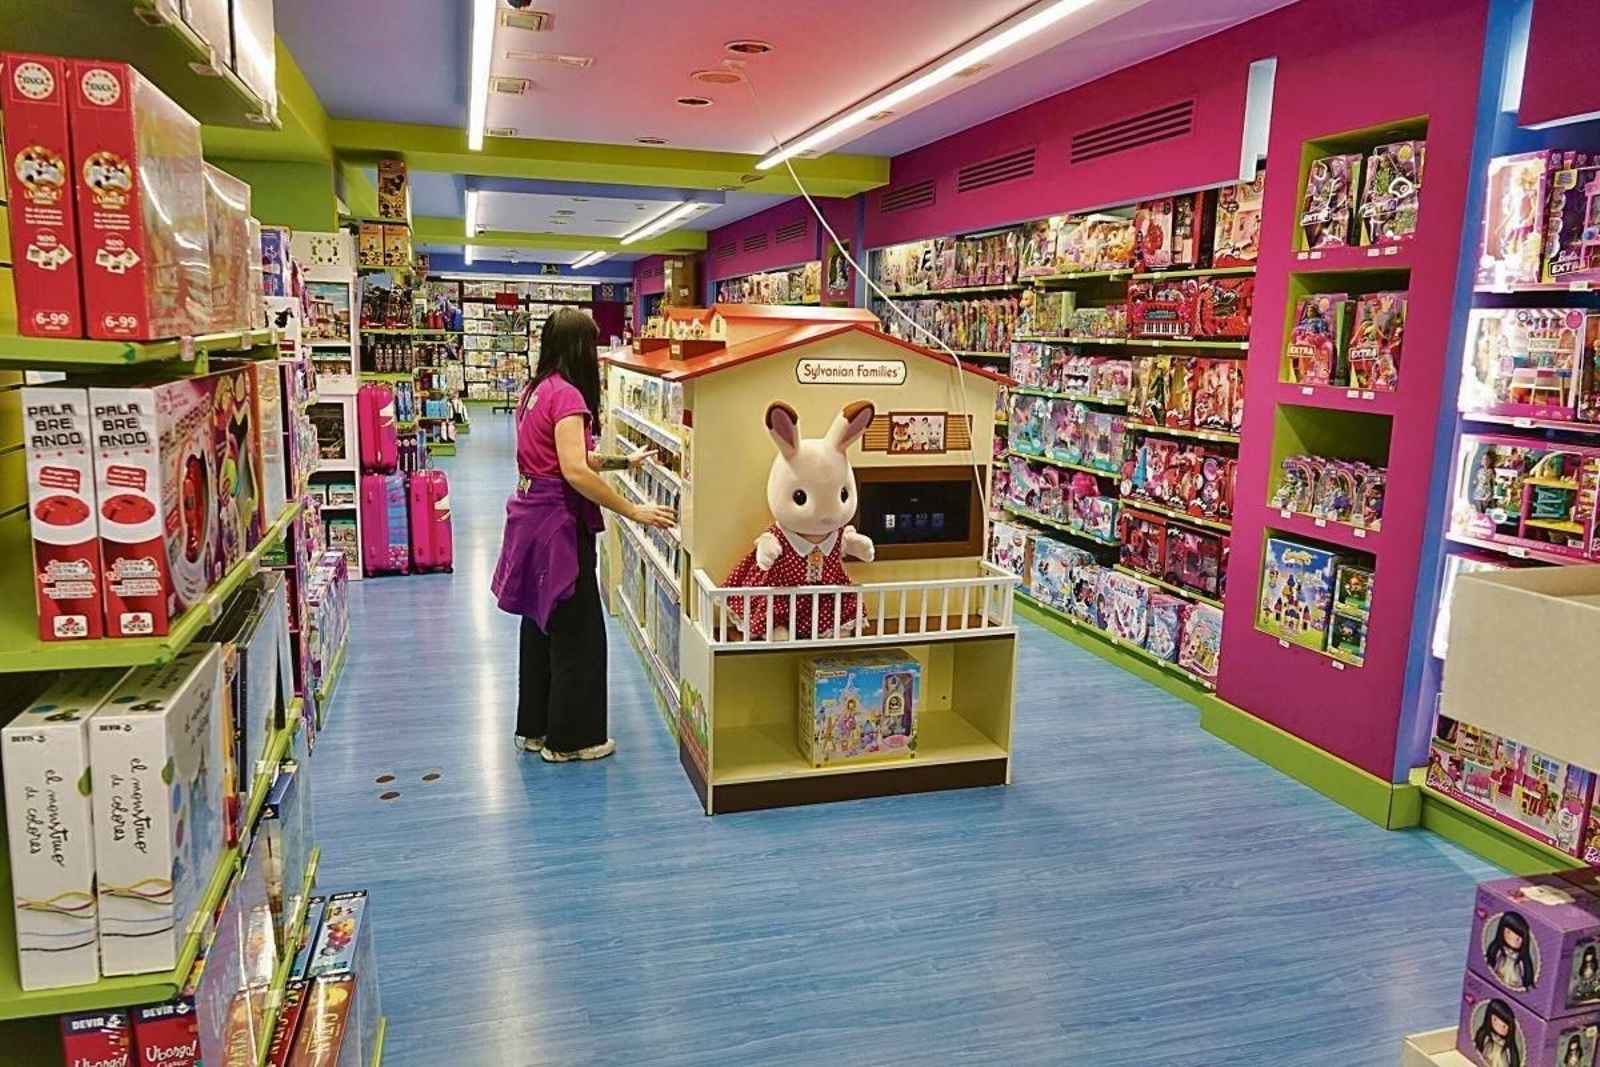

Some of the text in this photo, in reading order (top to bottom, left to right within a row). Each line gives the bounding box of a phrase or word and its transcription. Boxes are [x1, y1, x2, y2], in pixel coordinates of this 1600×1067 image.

[36, 312, 69, 325] 6-99
[105, 315, 137, 328] 6-99
[1291, 346, 1314, 355] EXTRA
[804, 363, 898, 380] Sylvanian Families
[28, 404, 74, 417] PALA
[95, 404, 140, 417] PALA
[35, 418, 72, 431] BRE
[103, 418, 138, 431] BRE
[32, 432, 82, 447] ANDO
[99, 432, 148, 447] ANDO
[110, 775, 128, 841] de colores
[130, 758, 152, 854] el monstruo
[25, 786, 44, 854] de colores
[45, 769, 69, 867] el monstruo
[142, 1005, 174, 1018] DEVIR
[71, 1018, 104, 1030] DEVIR
[309, 1012, 339, 1053] CATAN
[146, 1040, 197, 1062] Ubongo!
